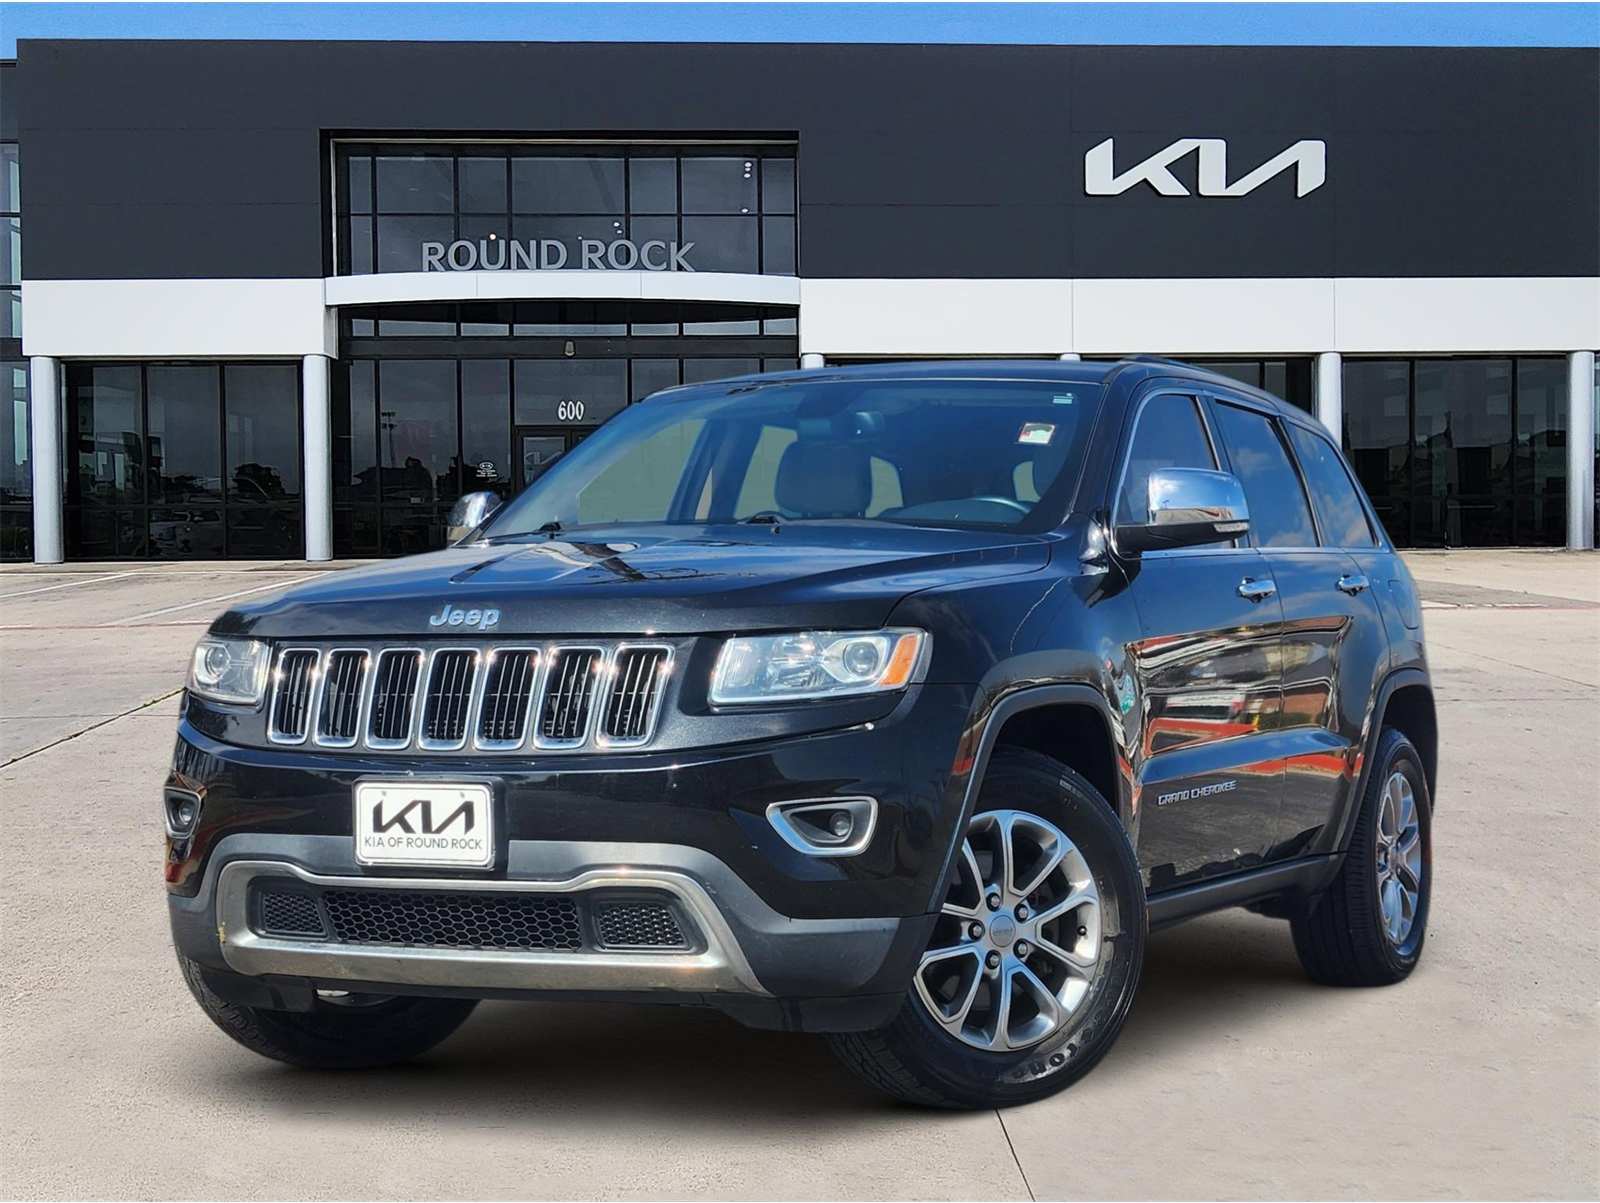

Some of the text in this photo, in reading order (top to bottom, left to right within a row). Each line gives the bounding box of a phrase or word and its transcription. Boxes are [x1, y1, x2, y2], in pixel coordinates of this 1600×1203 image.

[1085, 138, 1326, 198] KIA
[422, 239, 696, 272] ROUND ROCK
[557, 400, 584, 420] 600
[429, 604, 500, 630] Jeep
[1158, 780, 1237, 806] GRAND CHEROKEE
[373, 800, 475, 835] KIA
[364, 836, 483, 850] KIA OF ROUND ROCK
